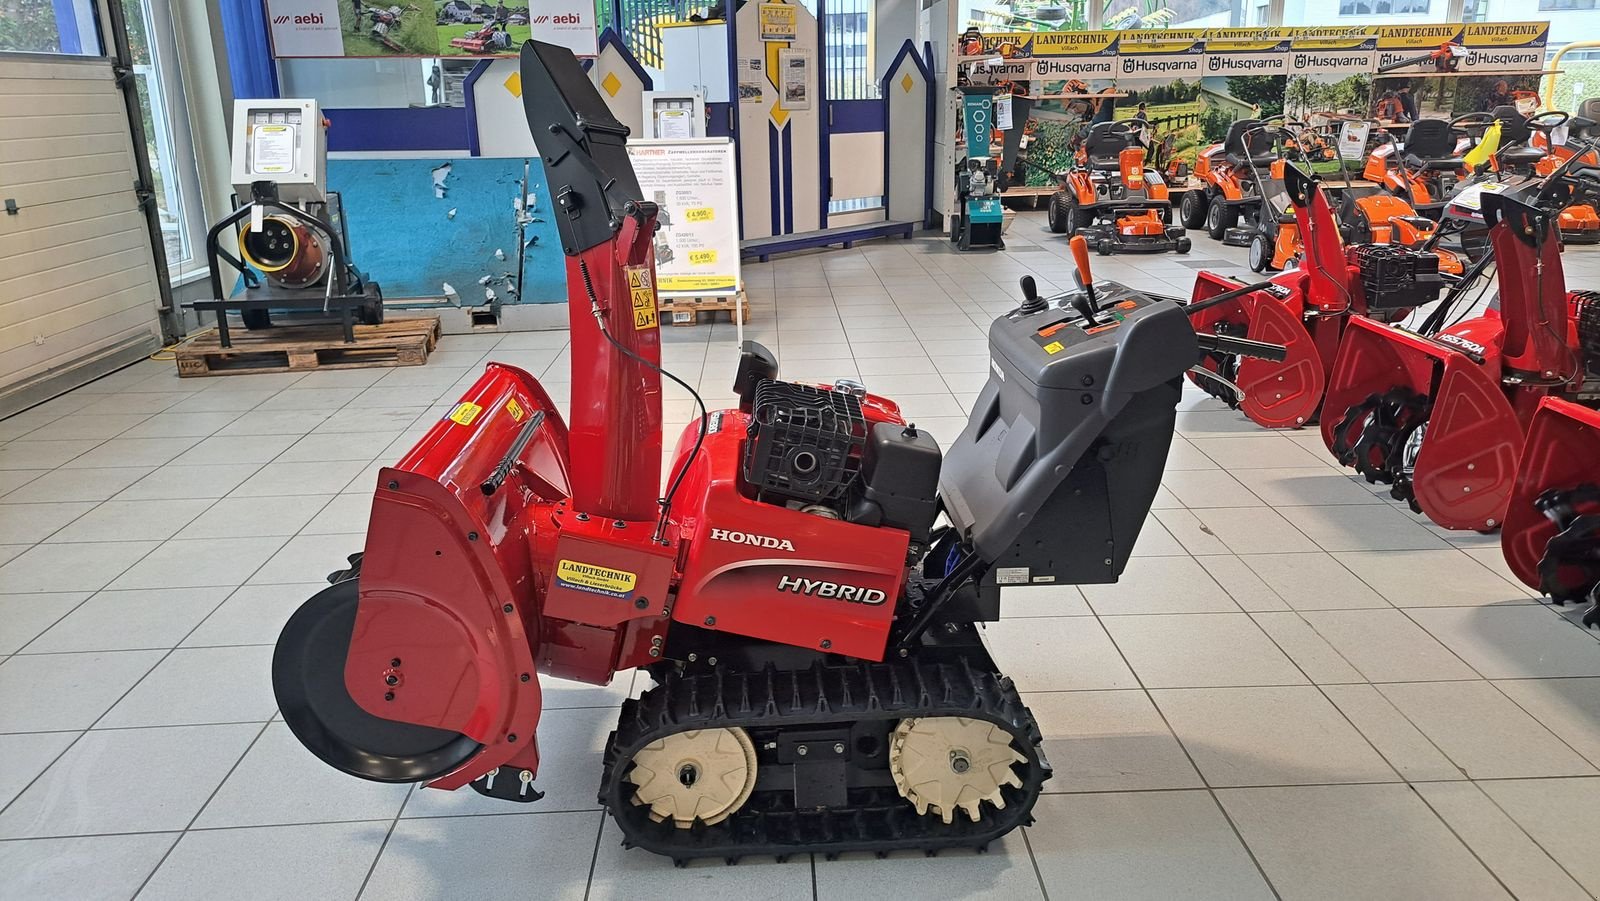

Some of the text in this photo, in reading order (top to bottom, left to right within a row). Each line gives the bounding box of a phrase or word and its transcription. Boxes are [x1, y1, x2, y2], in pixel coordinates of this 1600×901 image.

[294, 13, 324, 24] aebi
[553, 13, 580, 24] aebi
[1381, 27, 1453, 38] LANDTECHNIK
[1468, 25, 1538, 36] LANDTECHNIK
[1036, 34, 1108, 44] LANDTECHNIK
[1222, 58, 1282, 70] Husqvarna
[1307, 56, 1368, 68] Husqvarna
[1478, 53, 1538, 65] Husqvarna
[1050, 61, 1111, 74] Husqvarna
[1136, 60, 1197, 72] Husqvarna
[1438, 333, 1485, 354] HSS760A
[710, 528, 796, 551] HONDA
[562, 562, 632, 583] LANDTECHNIK
[560, 582, 625, 598] www.landtechnik.co.at
[777, 575, 887, 606] HYBRID
